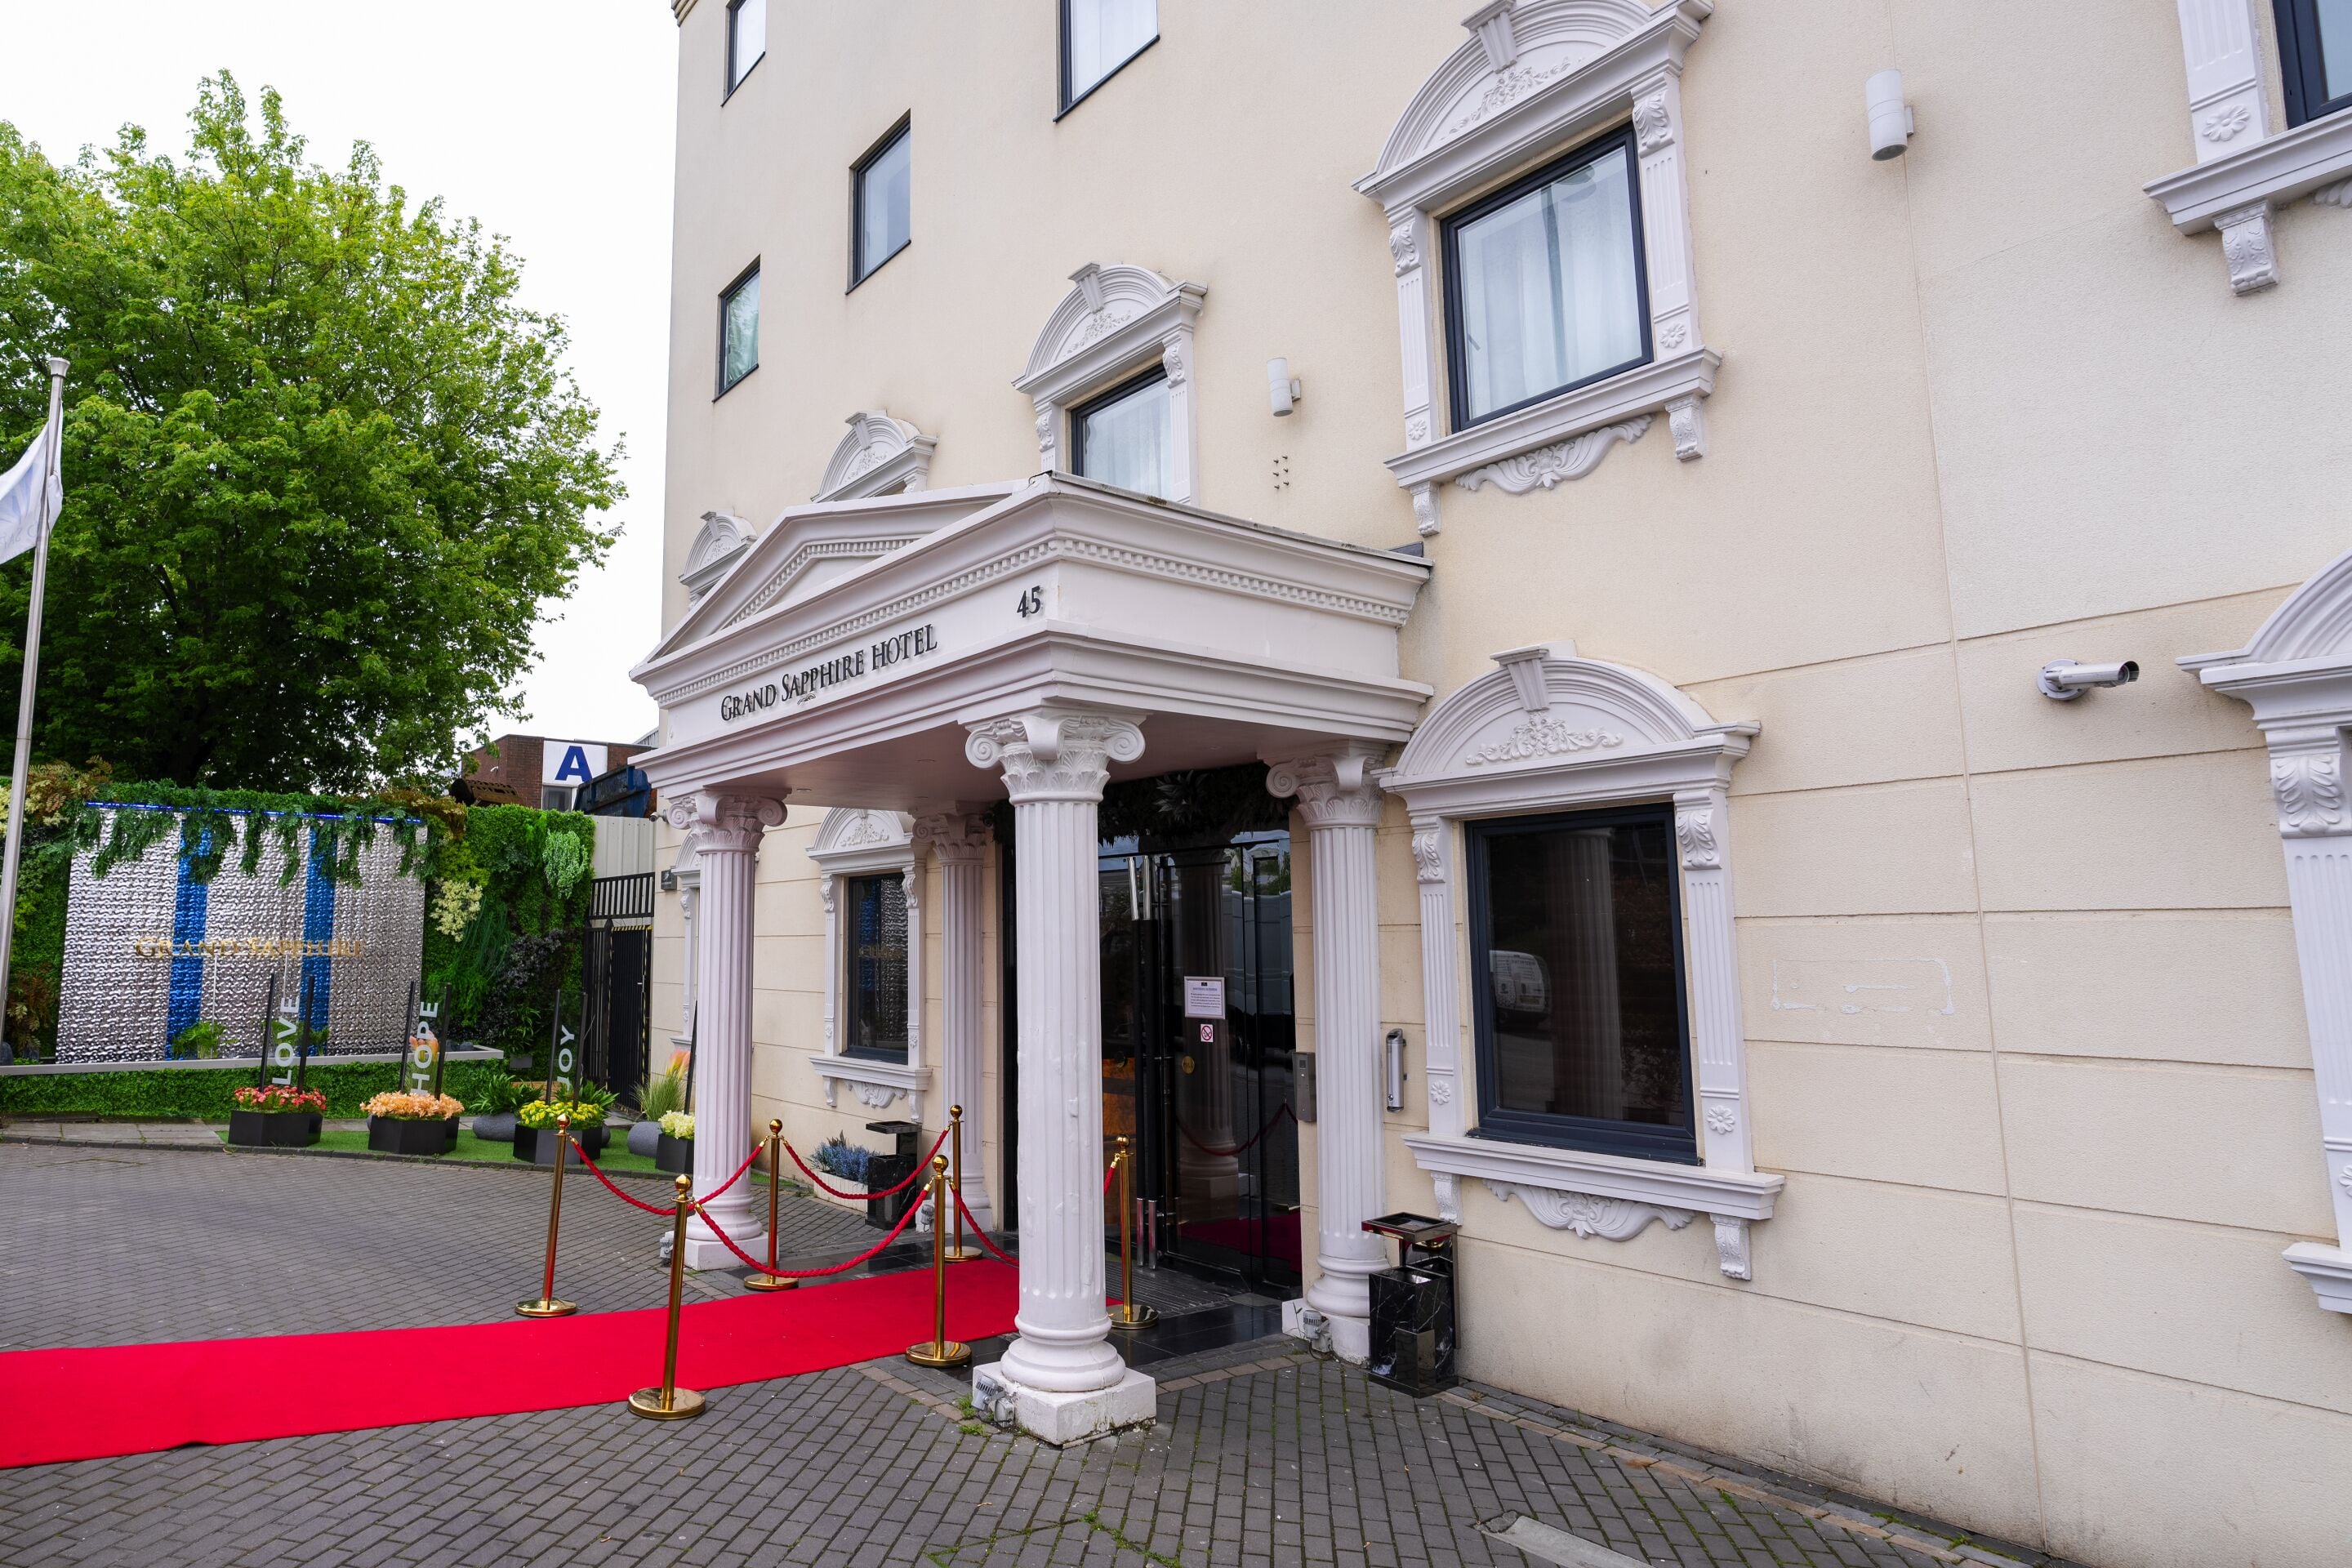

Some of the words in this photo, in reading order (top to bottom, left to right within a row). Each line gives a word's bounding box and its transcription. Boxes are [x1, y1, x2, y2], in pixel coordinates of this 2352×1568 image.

[1017, 586, 1041, 618] 45
[721, 684, 777, 721] GRAND
[782, 649, 864, 702] SAPPHIRE
[871, 624, 938, 671] HOTEL
[555, 746, 593, 782] A
[136, 937, 240, 957] GRAND
[272, 997, 300, 1085] LOVE
[411, 1001, 438, 1095] HOPE
[557, 1024, 575, 1091] JOY
